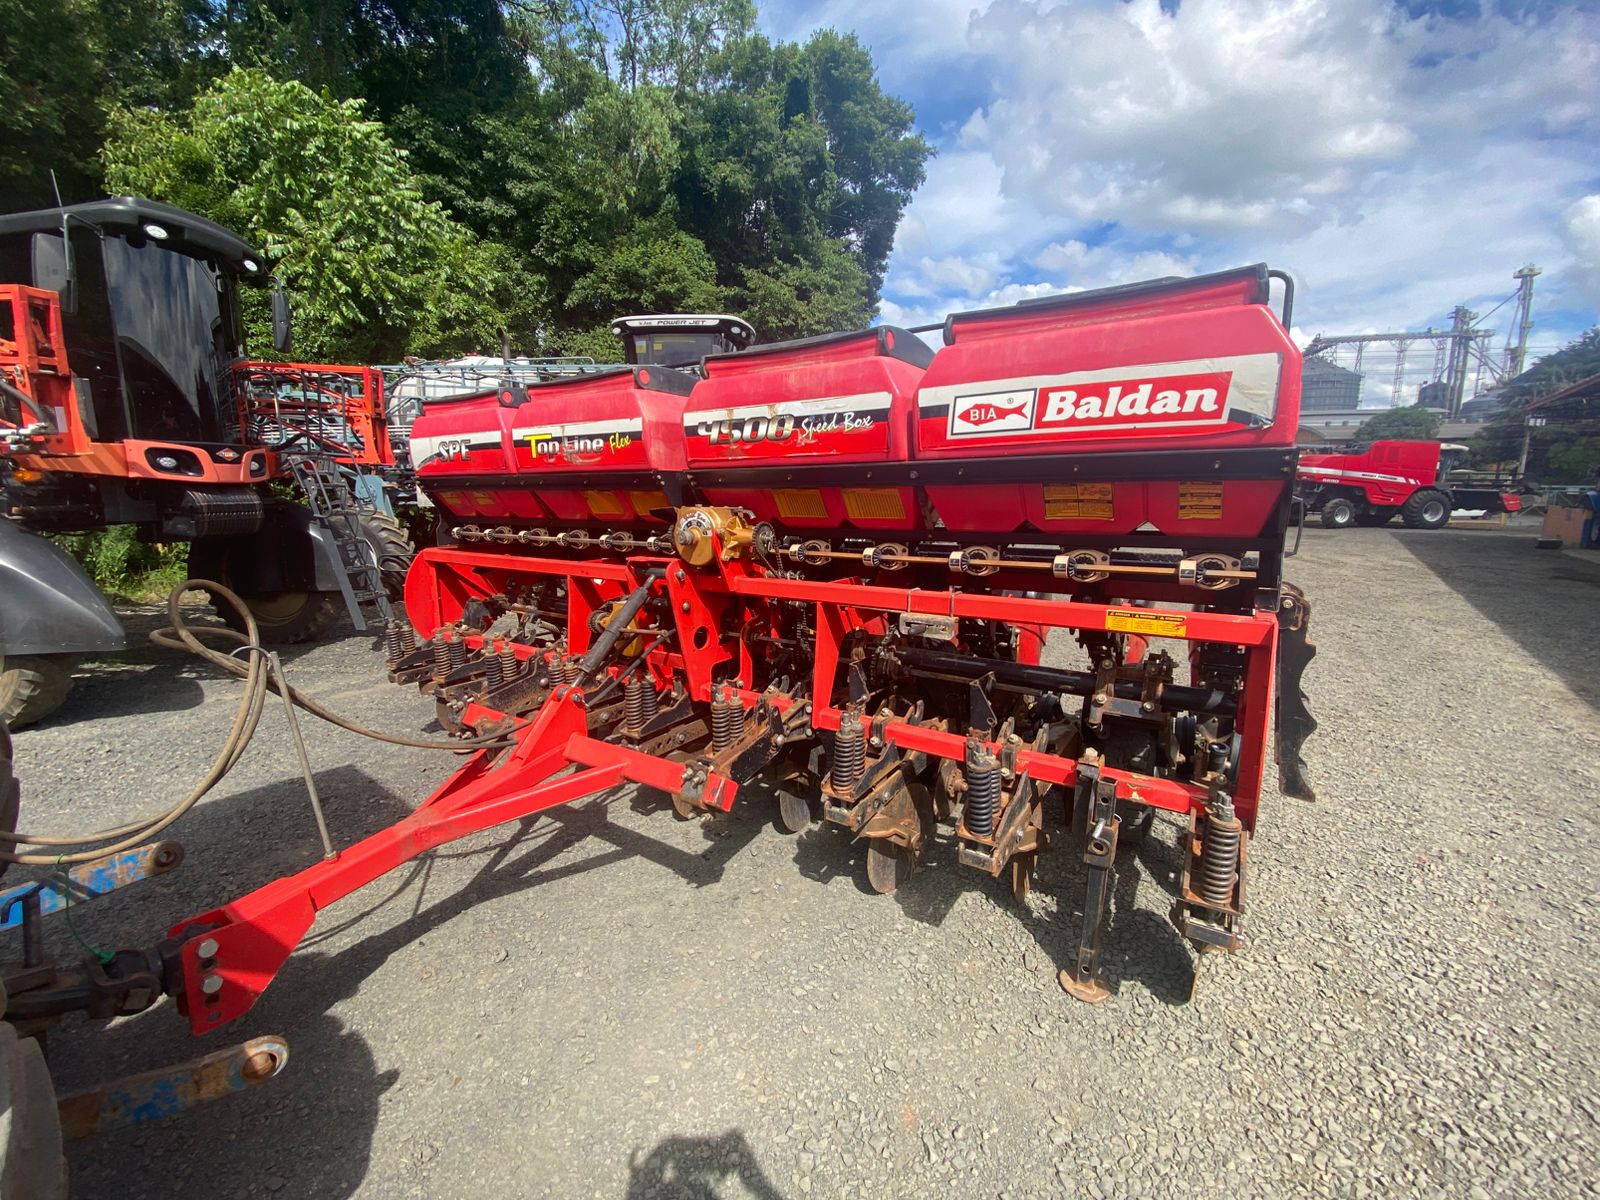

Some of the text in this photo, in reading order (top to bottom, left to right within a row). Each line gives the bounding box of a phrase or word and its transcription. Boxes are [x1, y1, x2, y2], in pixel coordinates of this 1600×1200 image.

[969, 408, 997, 422] BIA
[1042, 384, 1219, 422] Baldan
[697, 412, 873, 445] 4500 Speed Box
[438, 439, 471, 462] SPE
[523, 433, 560, 459] Top
